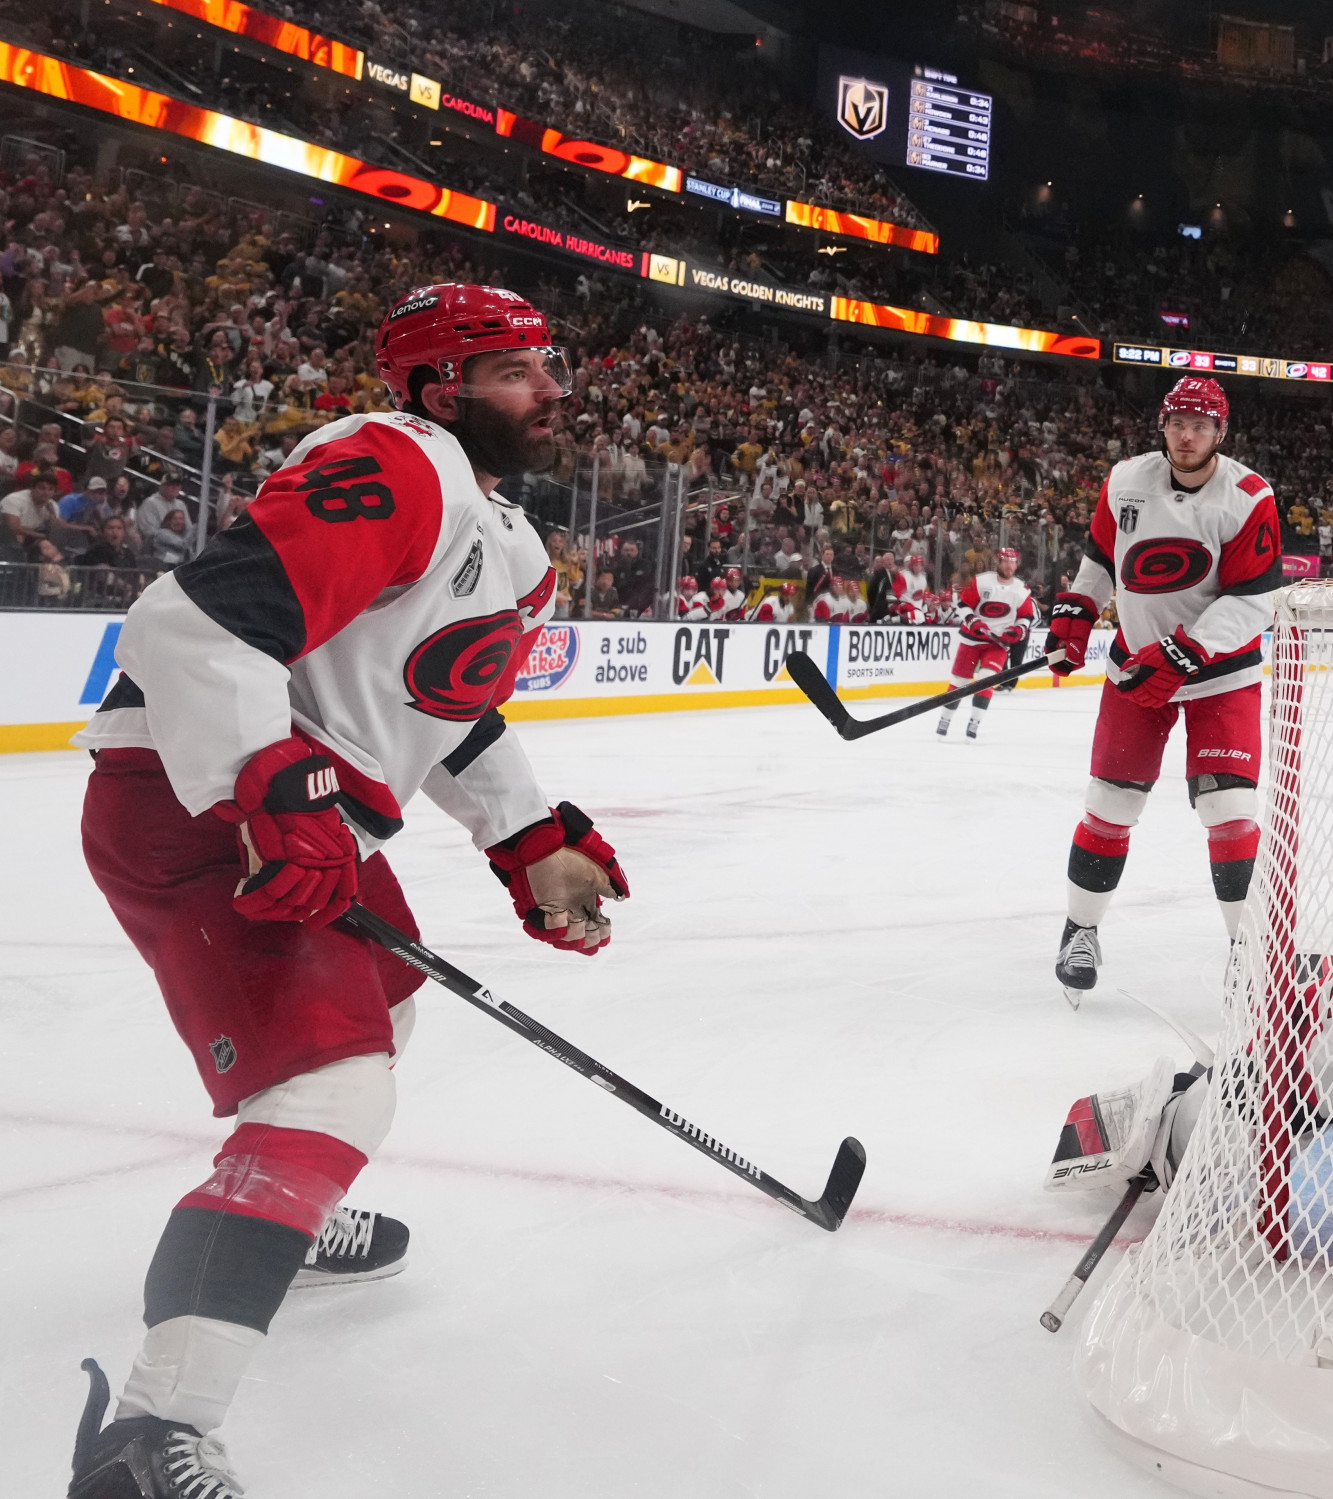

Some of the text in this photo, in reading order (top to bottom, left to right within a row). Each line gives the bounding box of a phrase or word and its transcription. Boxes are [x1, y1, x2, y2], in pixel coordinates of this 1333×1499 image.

[367, 62, 408, 91] VEGAS
[418, 84, 433, 100] VS
[442, 94, 494, 124] CAROLINA
[687, 177, 717, 198] STANLEY
[717, 186, 731, 200] CUP
[740, 194, 762, 209] FINAL
[503, 215, 633, 269] CAROLINA HURRICANES
[657, 262, 670, 277] VS
[692, 269, 825, 312] VEGAS GOLDEN KNIGHTS
[390, 297, 438, 319] Lenovo
[513, 317, 542, 326] CCM
[1144, 350, 1160, 363] PM
[1194, 354, 1210, 368] 33
[1311, 367, 1327, 379] 42
[294, 455, 396, 525] 48
[600, 631, 647, 654] a sub
[849, 630, 951, 663] BODYARMOR
[672, 627, 730, 685] CAT
[1160, 635, 1199, 675] CCM
[595, 659, 648, 683] above
[847, 667, 894, 678] SPORTS DRINK
[528, 678, 551, 690] SUBS
[1197, 748, 1252, 762] BAUER
[390, 947, 447, 982] WARRIOR
[533, 1039, 562, 1058] ALPHA
[659, 1103, 763, 1181] WARRIOR
[1053, 1157, 1113, 1179] TRUE
